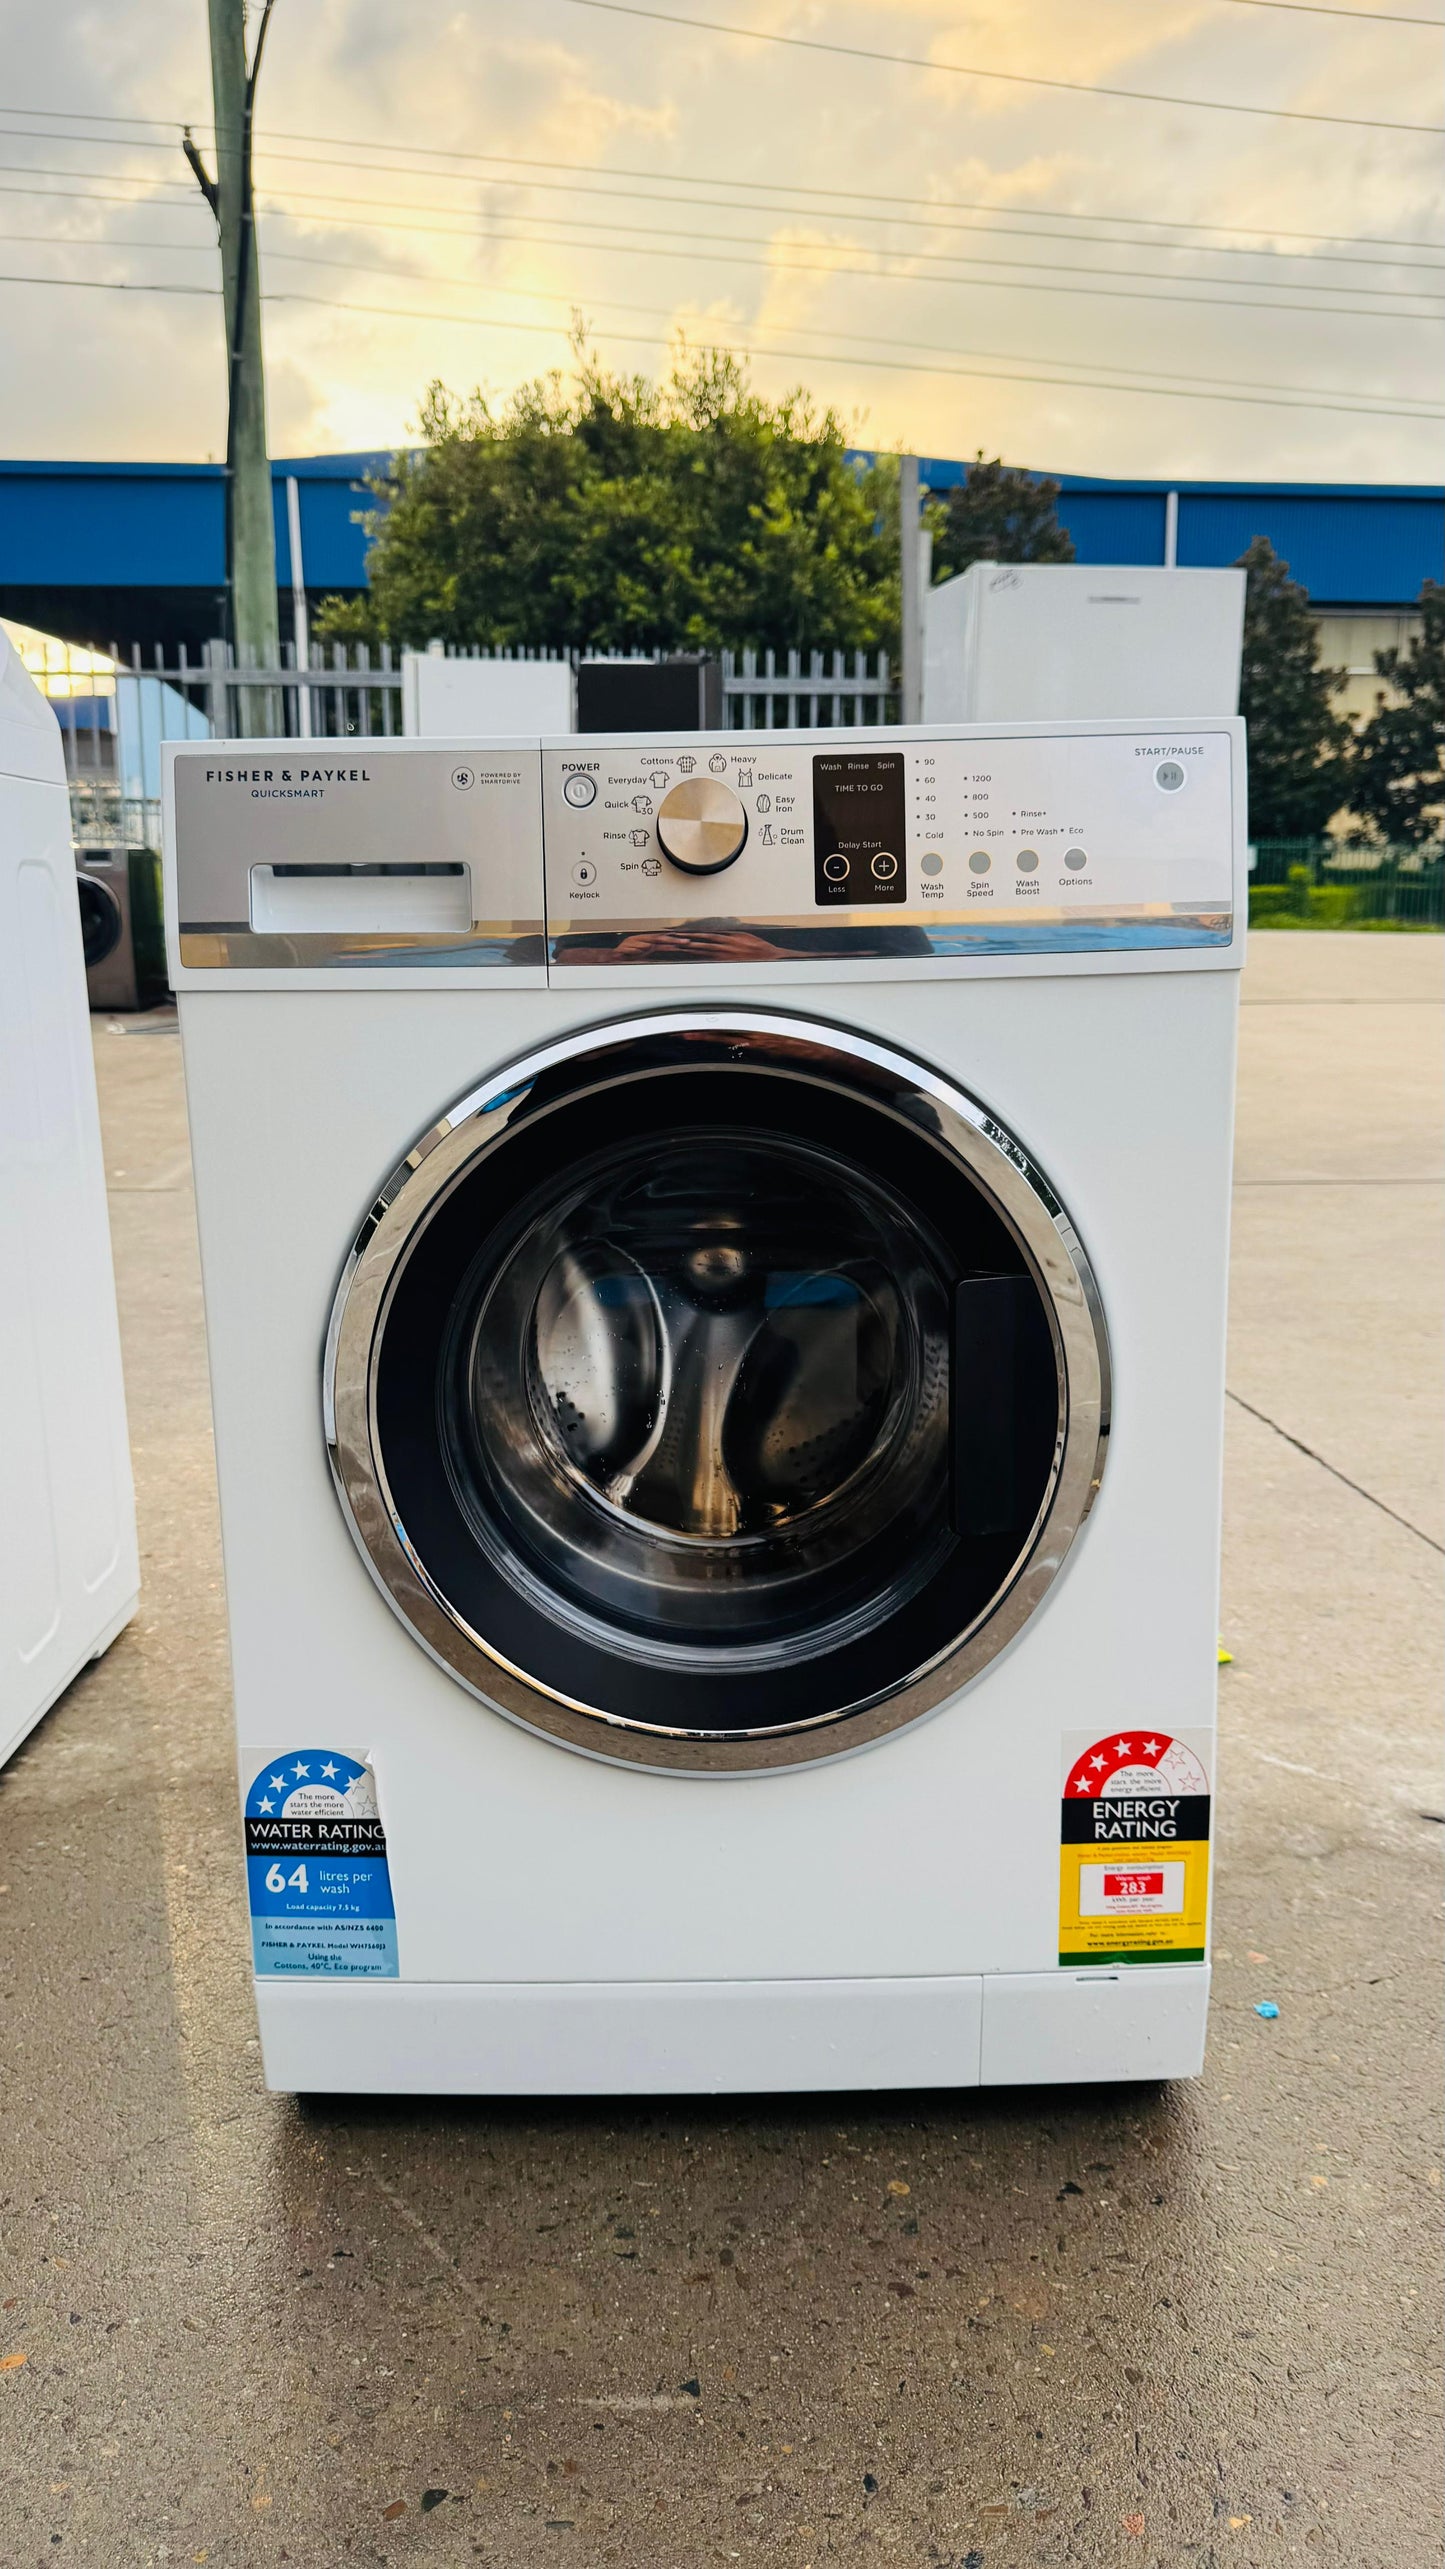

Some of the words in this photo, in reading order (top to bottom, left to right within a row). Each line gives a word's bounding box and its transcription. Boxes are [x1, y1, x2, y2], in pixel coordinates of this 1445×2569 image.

[1134, 746, 1204, 757] START/PAUSE
[640, 757, 674, 765] Cottons
[731, 755, 757, 765] Heavy
[562, 763, 600, 771] POWER
[820, 763, 842, 771] Wash
[848, 762, 869, 770] Rinse
[877, 761, 894, 771] Spin
[206, 770, 273, 782] FISHER
[281, 770, 293, 782] &
[300, 769, 371, 781] PAYKEL
[608, 775, 647, 785] Everyday
[758, 772, 792, 781] Delicate
[924, 776, 935, 784] 60
[972, 775, 992, 783] 1200
[835, 784, 854, 792] TIME
[857, 784, 868, 792] TO
[870, 784, 883, 792] GO
[251, 789, 325, 798] QUICKSMART
[604, 800, 629, 810] Quick
[775, 795, 795, 806] Easy
[641, 807, 653, 815] 30
[775, 804, 793, 812] Iron
[603, 832, 626, 840] Rinse
[780, 827, 804, 836] Drum
[986, 829, 1004, 837] Spin
[780, 836, 805, 845] Clean
[838, 841, 860, 850] Delay
[863, 840, 881, 848] Start
[620, 862, 639, 872] Spin
[1016, 879, 1039, 888] Wash
[1059, 876, 1092, 886] Options
[875, 884, 894, 892] More
[921, 883, 944, 891] Wash
[971, 881, 990, 891] Spin
[570, 891, 600, 900] Keylock
[921, 890, 944, 900] Temp
[967, 889, 994, 899] Speed
[1016, 887, 1040, 895] Boost
[1093, 1800, 1180, 1819] ENERGY
[250, 1823, 313, 1838] WATER
[318, 1824, 385, 1839] RATING
[1094, 1821, 1177, 1839] RATING
[265, 1863, 309, 1894] 64
[320, 1871, 349, 1881] litres
[353, 1873, 373, 1884] per
[320, 1884, 349, 1894] wash
[1120, 1882, 1146, 1894] 283
[351, 1904, 360, 1912] kg
[308, 1953, 328, 1961] Using
